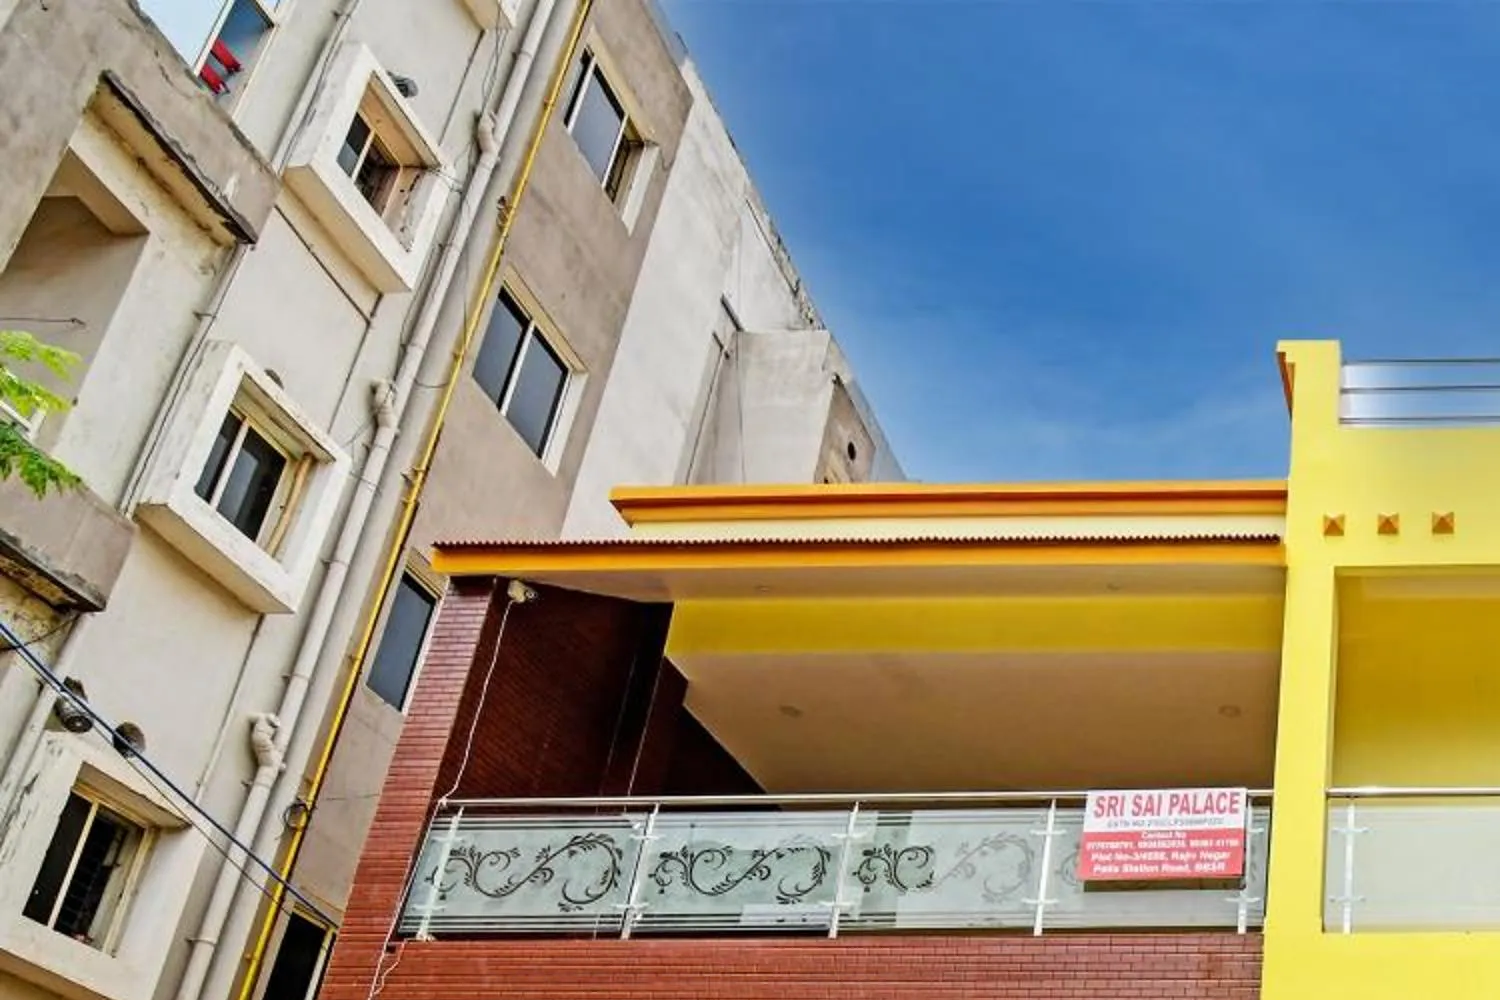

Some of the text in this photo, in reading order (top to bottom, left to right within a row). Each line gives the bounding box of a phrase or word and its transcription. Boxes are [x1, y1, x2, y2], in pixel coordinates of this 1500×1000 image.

[1094, 791, 1240, 818] SRI SAI PALACE
